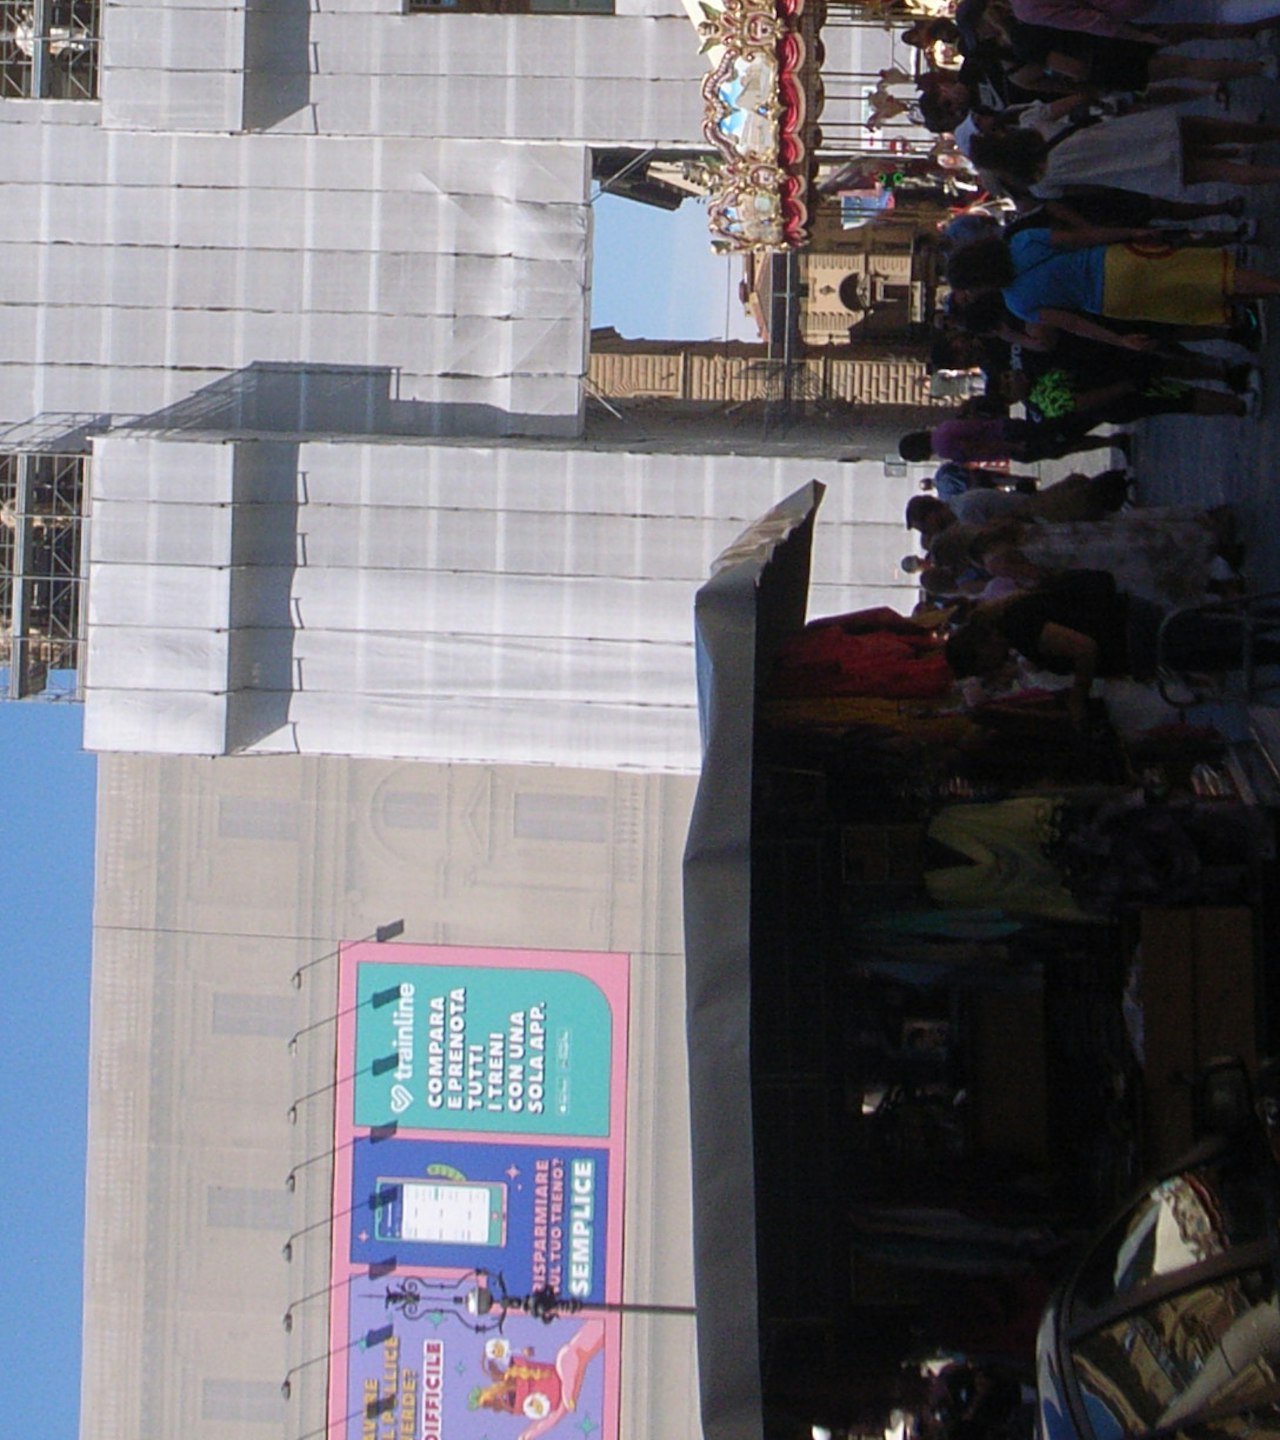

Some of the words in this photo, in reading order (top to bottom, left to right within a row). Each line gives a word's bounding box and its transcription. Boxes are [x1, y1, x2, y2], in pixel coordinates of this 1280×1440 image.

[391, 982, 414, 1080] trainline
[427, 997, 446, 1108] COMPARA
[448, 988, 466, 1092] PRENOTA
[508, 1011, 526, 1059] UNA
[528, 1002, 546, 1051] APP.
[466, 1044, 484, 1110] TUTTI
[488, 1032, 505, 1099] TRENI
[507, 1064, 524, 1112] CON
[526, 1055, 545, 1114] SOLA
[446, 1094, 464, 1109] E
[487, 1104, 504, 1112] I
[552, 1158, 564, 1222] TRENO?
[550, 1227, 562, 1262] TUO
[571, 1161, 592, 1296] SEMPLICE
[363, 1378, 378, 1440] AVRE
[381, 1335, 400, 1425] PLLICE
